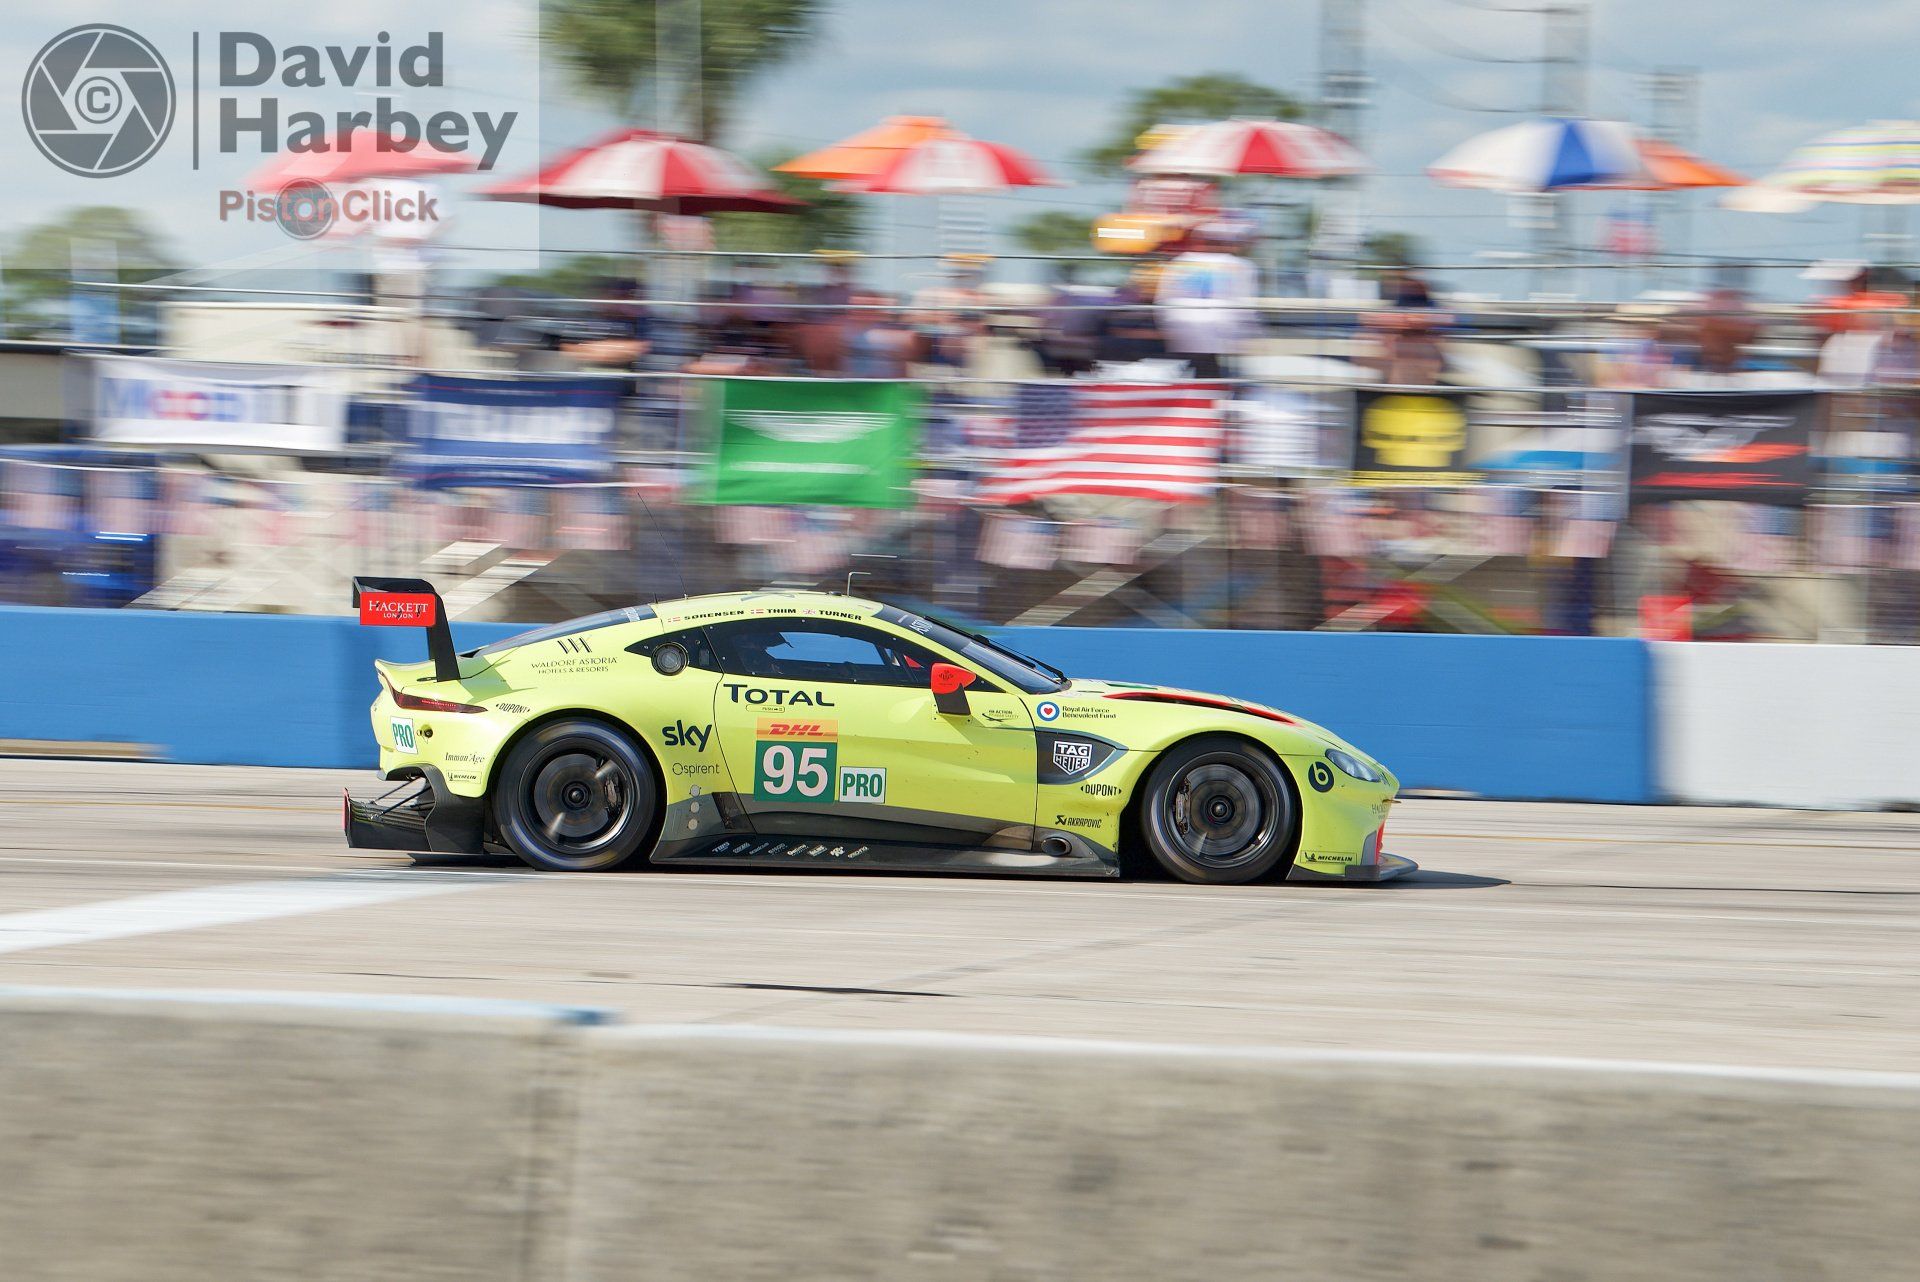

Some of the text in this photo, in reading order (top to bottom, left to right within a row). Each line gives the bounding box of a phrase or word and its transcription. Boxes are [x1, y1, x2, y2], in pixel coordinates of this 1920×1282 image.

[368, 600, 429, 613] HACKETT
[818, 609, 862, 621] TURNER
[531, 657, 618, 668] WALDORF ASTORIA
[499, 703, 527, 714] DUPONT
[1062, 705, 1080, 713] Royal
[392, 723, 414, 749] PRO
[661, 720, 712, 752] sky
[769, 723, 824, 736] DHL
[1057, 744, 1088, 756] TAG
[1055, 756, 1088, 772] HEUER
[762, 745, 828, 797] 95
[842, 773, 883, 797] PRO
[1085, 784, 1117, 796] DUPONT
